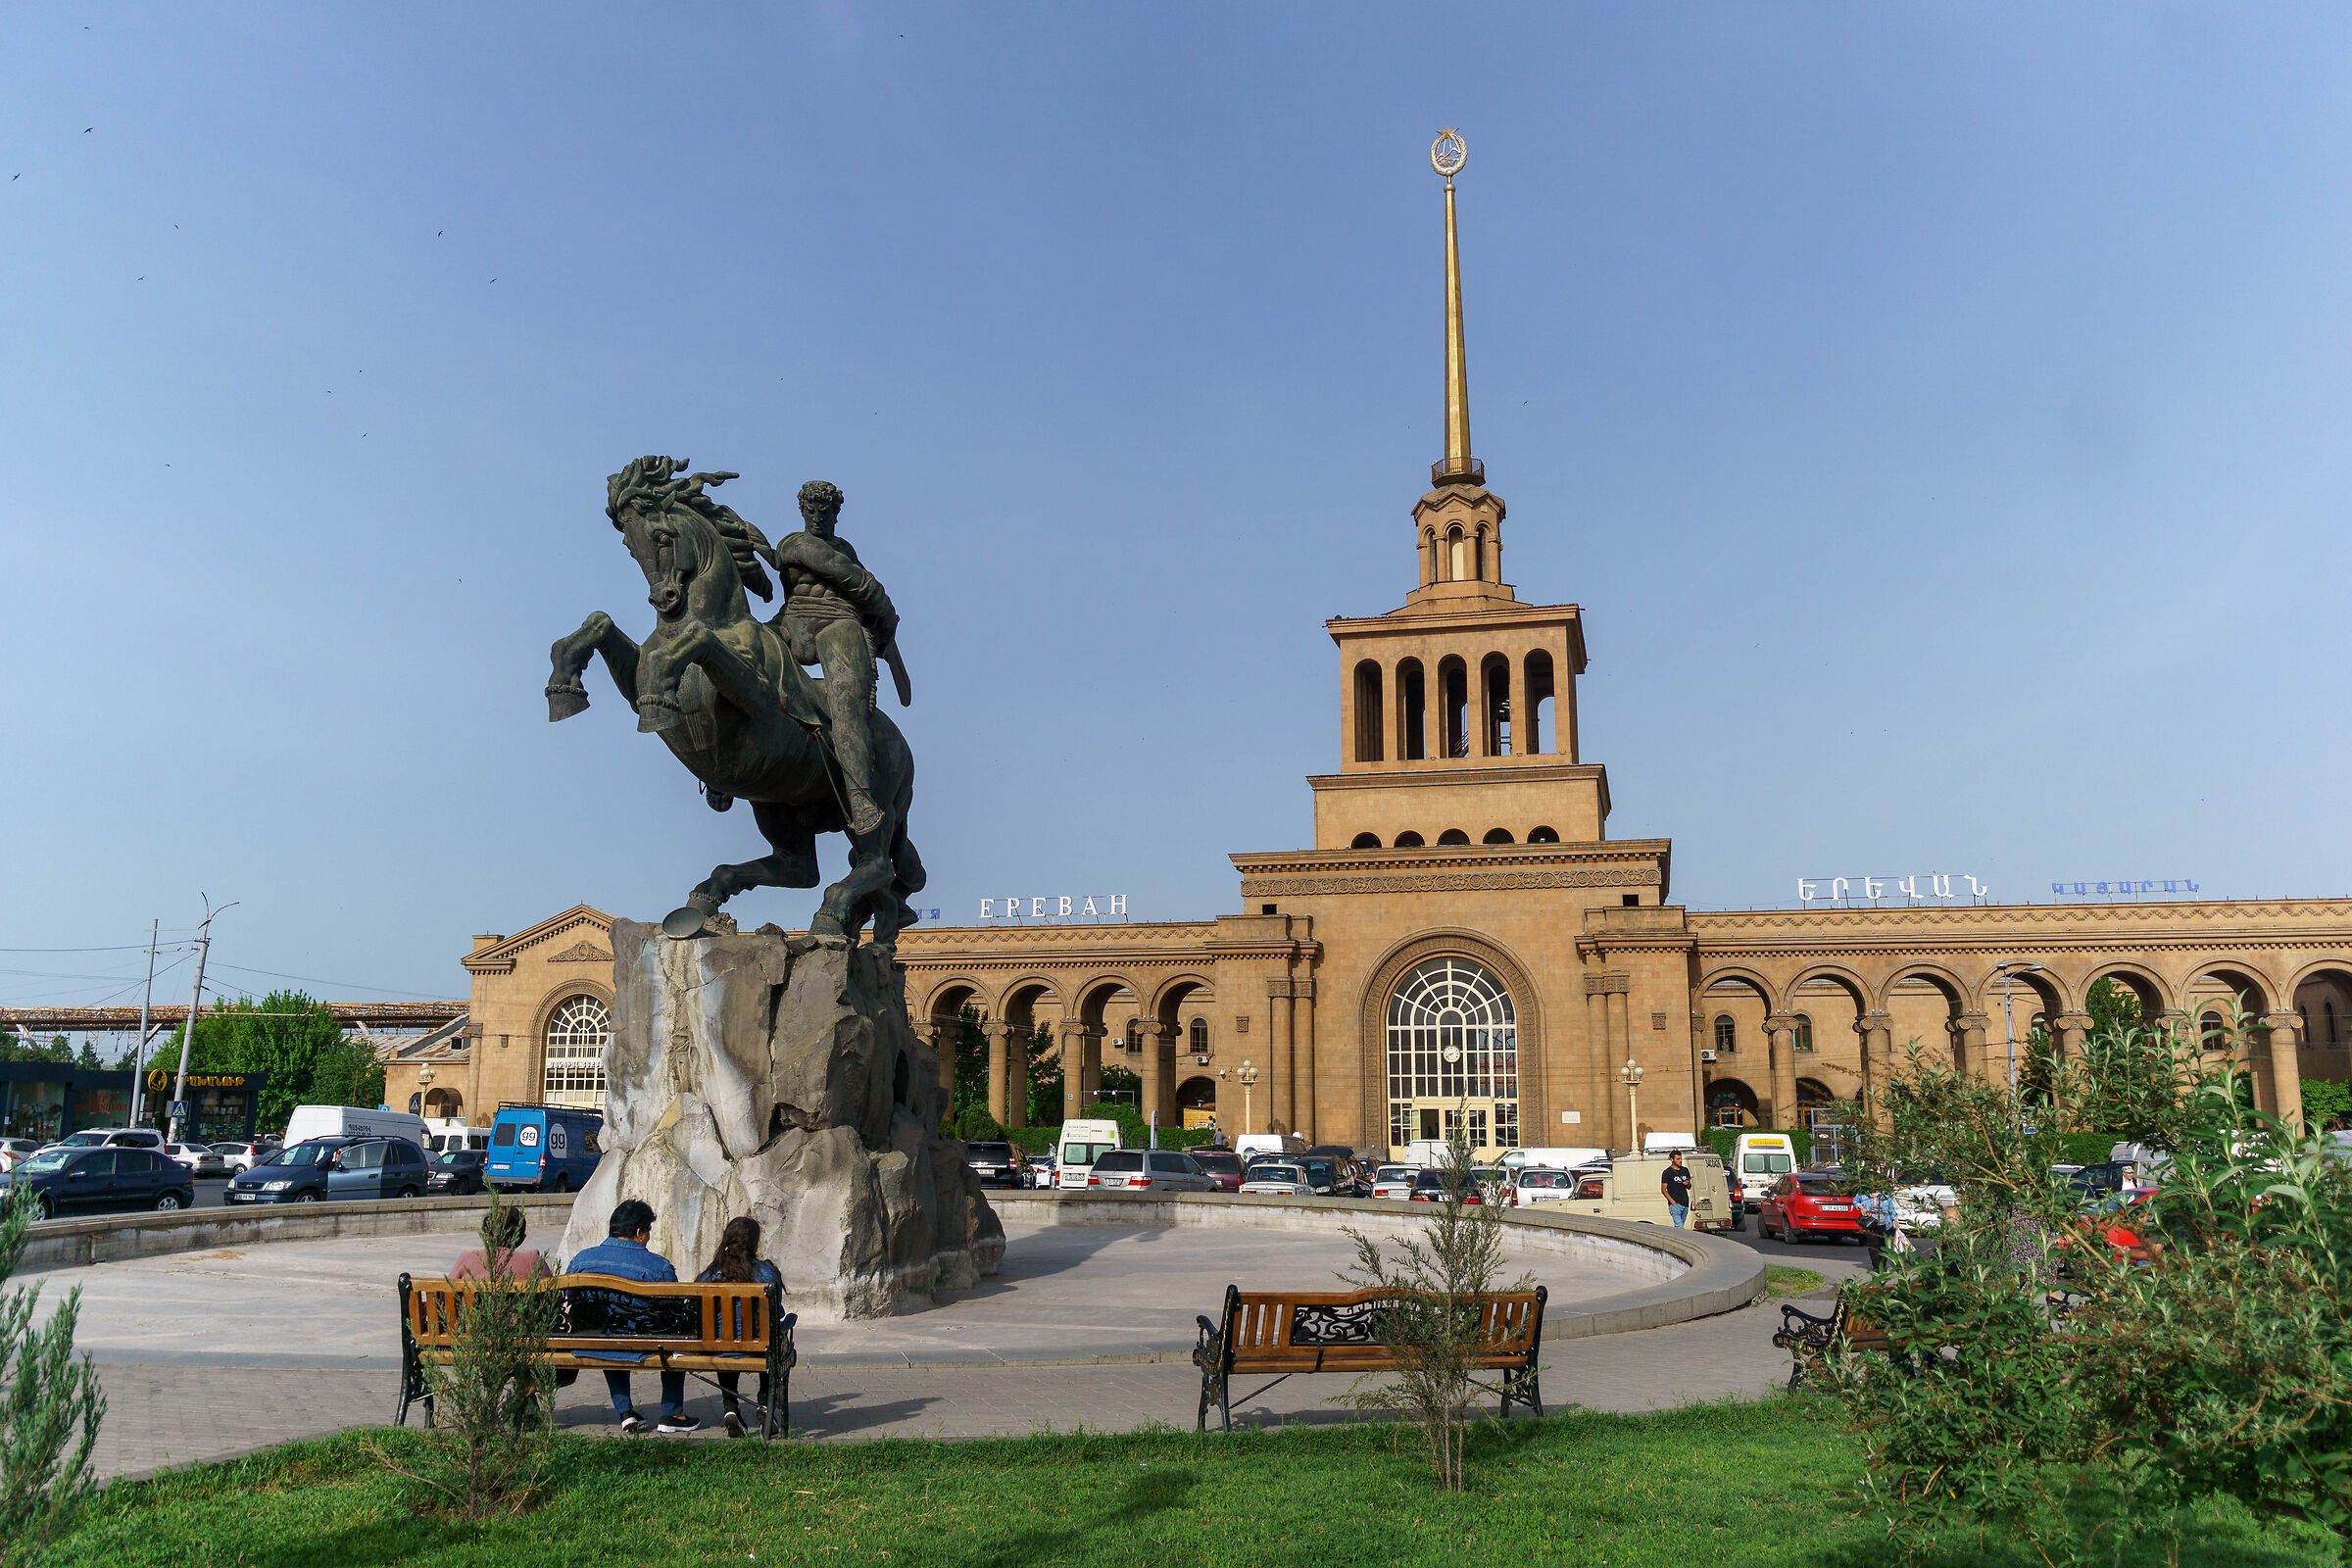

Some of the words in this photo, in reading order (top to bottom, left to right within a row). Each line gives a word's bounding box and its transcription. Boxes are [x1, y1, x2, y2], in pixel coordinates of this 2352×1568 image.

[1797, 874, 1988, 901] ԵՐԵՎԱՆ
[980, 894, 1128, 918] ЕРЕВАН
[521, 1131, 536, 1142] gg
[550, 1133, 565, 1150] gg
